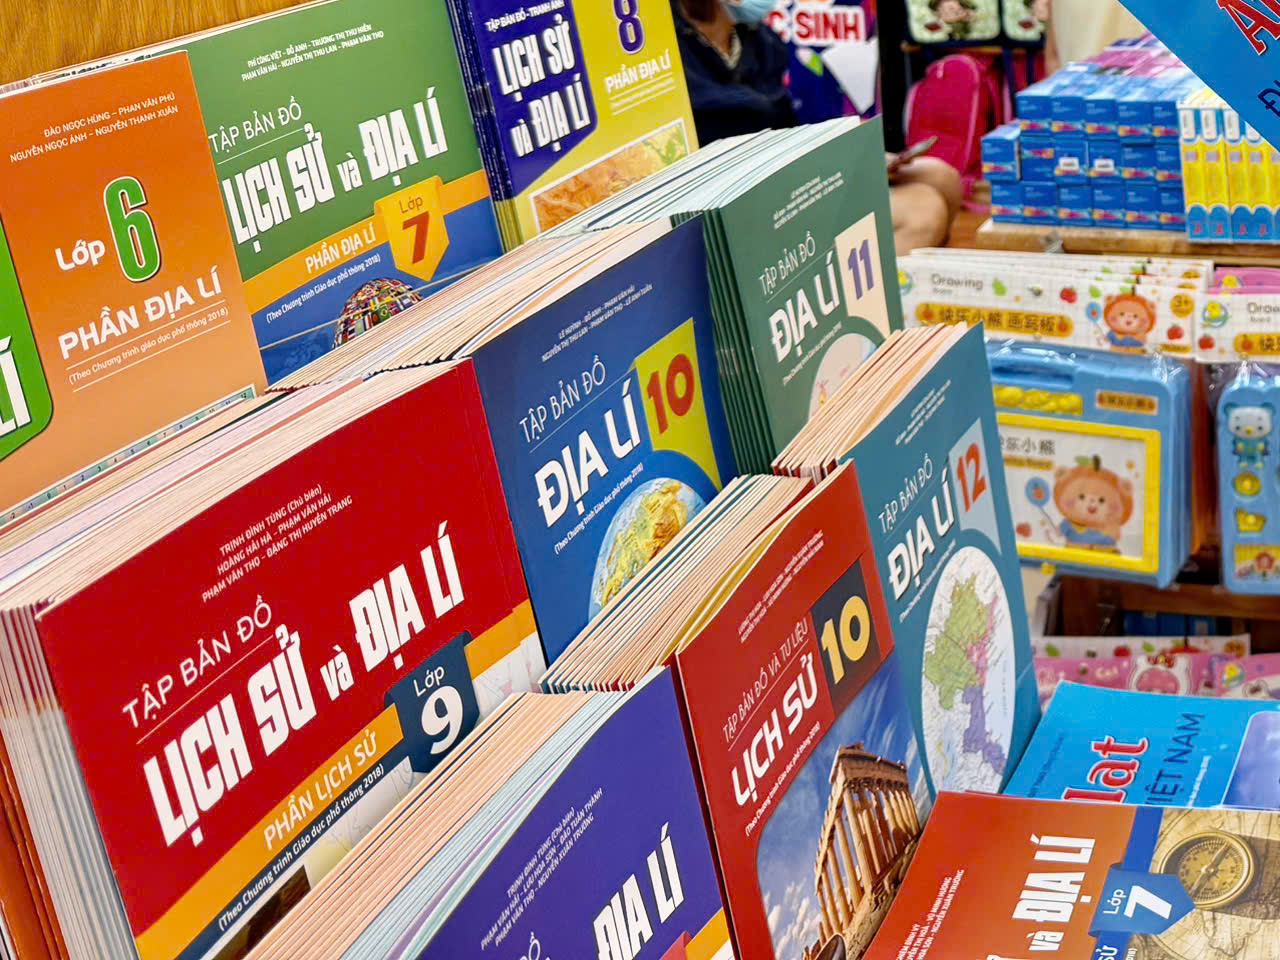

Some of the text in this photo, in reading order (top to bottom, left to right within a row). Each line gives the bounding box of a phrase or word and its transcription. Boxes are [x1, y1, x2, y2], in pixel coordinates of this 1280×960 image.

[492, 34, 545, 102] LỊCH
[543, 14, 575, 74] SỬ
[660, 49, 672, 71] LÍ
[796, 11, 860, 40] SINH
[9, 144, 43, 162] NGUYỄN
[44, 136, 69, 152] NGỌC
[94, 119, 126, 136] NGUYỄN
[128, 110, 156, 126] THANH
[43, 91, 175, 138] ĐÀO NGỌC HÙNG PHAN VĂN PHÚ
[208, 95, 302, 153] TẬP BẢN ĐỒ
[529, 92, 570, 152] ĐỊA
[568, 73, 590, 131] LÍ
[222, 87, 448, 253] LỊCH SỬ và ĐỊA LÍ
[399, 195, 423, 214] Lớp
[55, 239, 105, 271] Lớp
[103, 176, 162, 283] 6
[304, 220, 376, 274] PHẦN ĐỊA LÍ
[402, 211, 430, 264] 7
[759, 231, 816, 295] TẬP BẢN ĐỒ
[848, 239, 874, 300] 11
[931, 273, 984, 291] Drawing
[57, 265, 222, 360] PHẦN ĐỊA LÍ
[769, 289, 818, 363] ĐỊA
[815, 250, 840, 317] LÍ
[68, 305, 228, 385] (Theo Chương trình giáo dục phổ thông 2018)
[519, 355, 606, 442] TẬP BẢN ĐỒ
[647, 353, 695, 434] 10
[535, 377, 641, 528] ĐỊA LÍ
[956, 442, 986, 512] 12
[219, 483, 322, 557] TRỊNH ĐÌNH TÙNG (Chủ biên)
[878, 453, 933, 533] TẬP BẢN ĐỒ
[887, 515, 935, 600] ĐỊA
[932, 467, 955, 537] LÍ
[122, 593, 272, 728] TẬP BẢN ĐỒ
[821, 595, 871, 685] 10
[143, 519, 465, 847] LỊCH SỬ và ĐỊA LÍ
[413, 665, 445, 697] Lớp
[722, 618, 808, 744] TẬP BẢN ĐỒ VÀ TƯ LIỆU
[421, 685, 464, 755] 9
[731, 712, 784, 806] LỊCH
[782, 653, 818, 735] SỬ
[1163, 713, 1204, 763] NAM
[263, 729, 377, 851] PHẦN LỊCH SỬ
[217, 763, 384, 932] (Theo Chương trình Giáo dục phổ thông 2018)
[646, 822, 685, 924] LÍ
[1030, 834, 1096, 864] LÍ
[1011, 871, 1092, 923] ĐỊA
[1103, 889, 1126, 915] Lớp
[1123, 885, 1172, 920] 7
[1026, 930, 1065, 951] và
